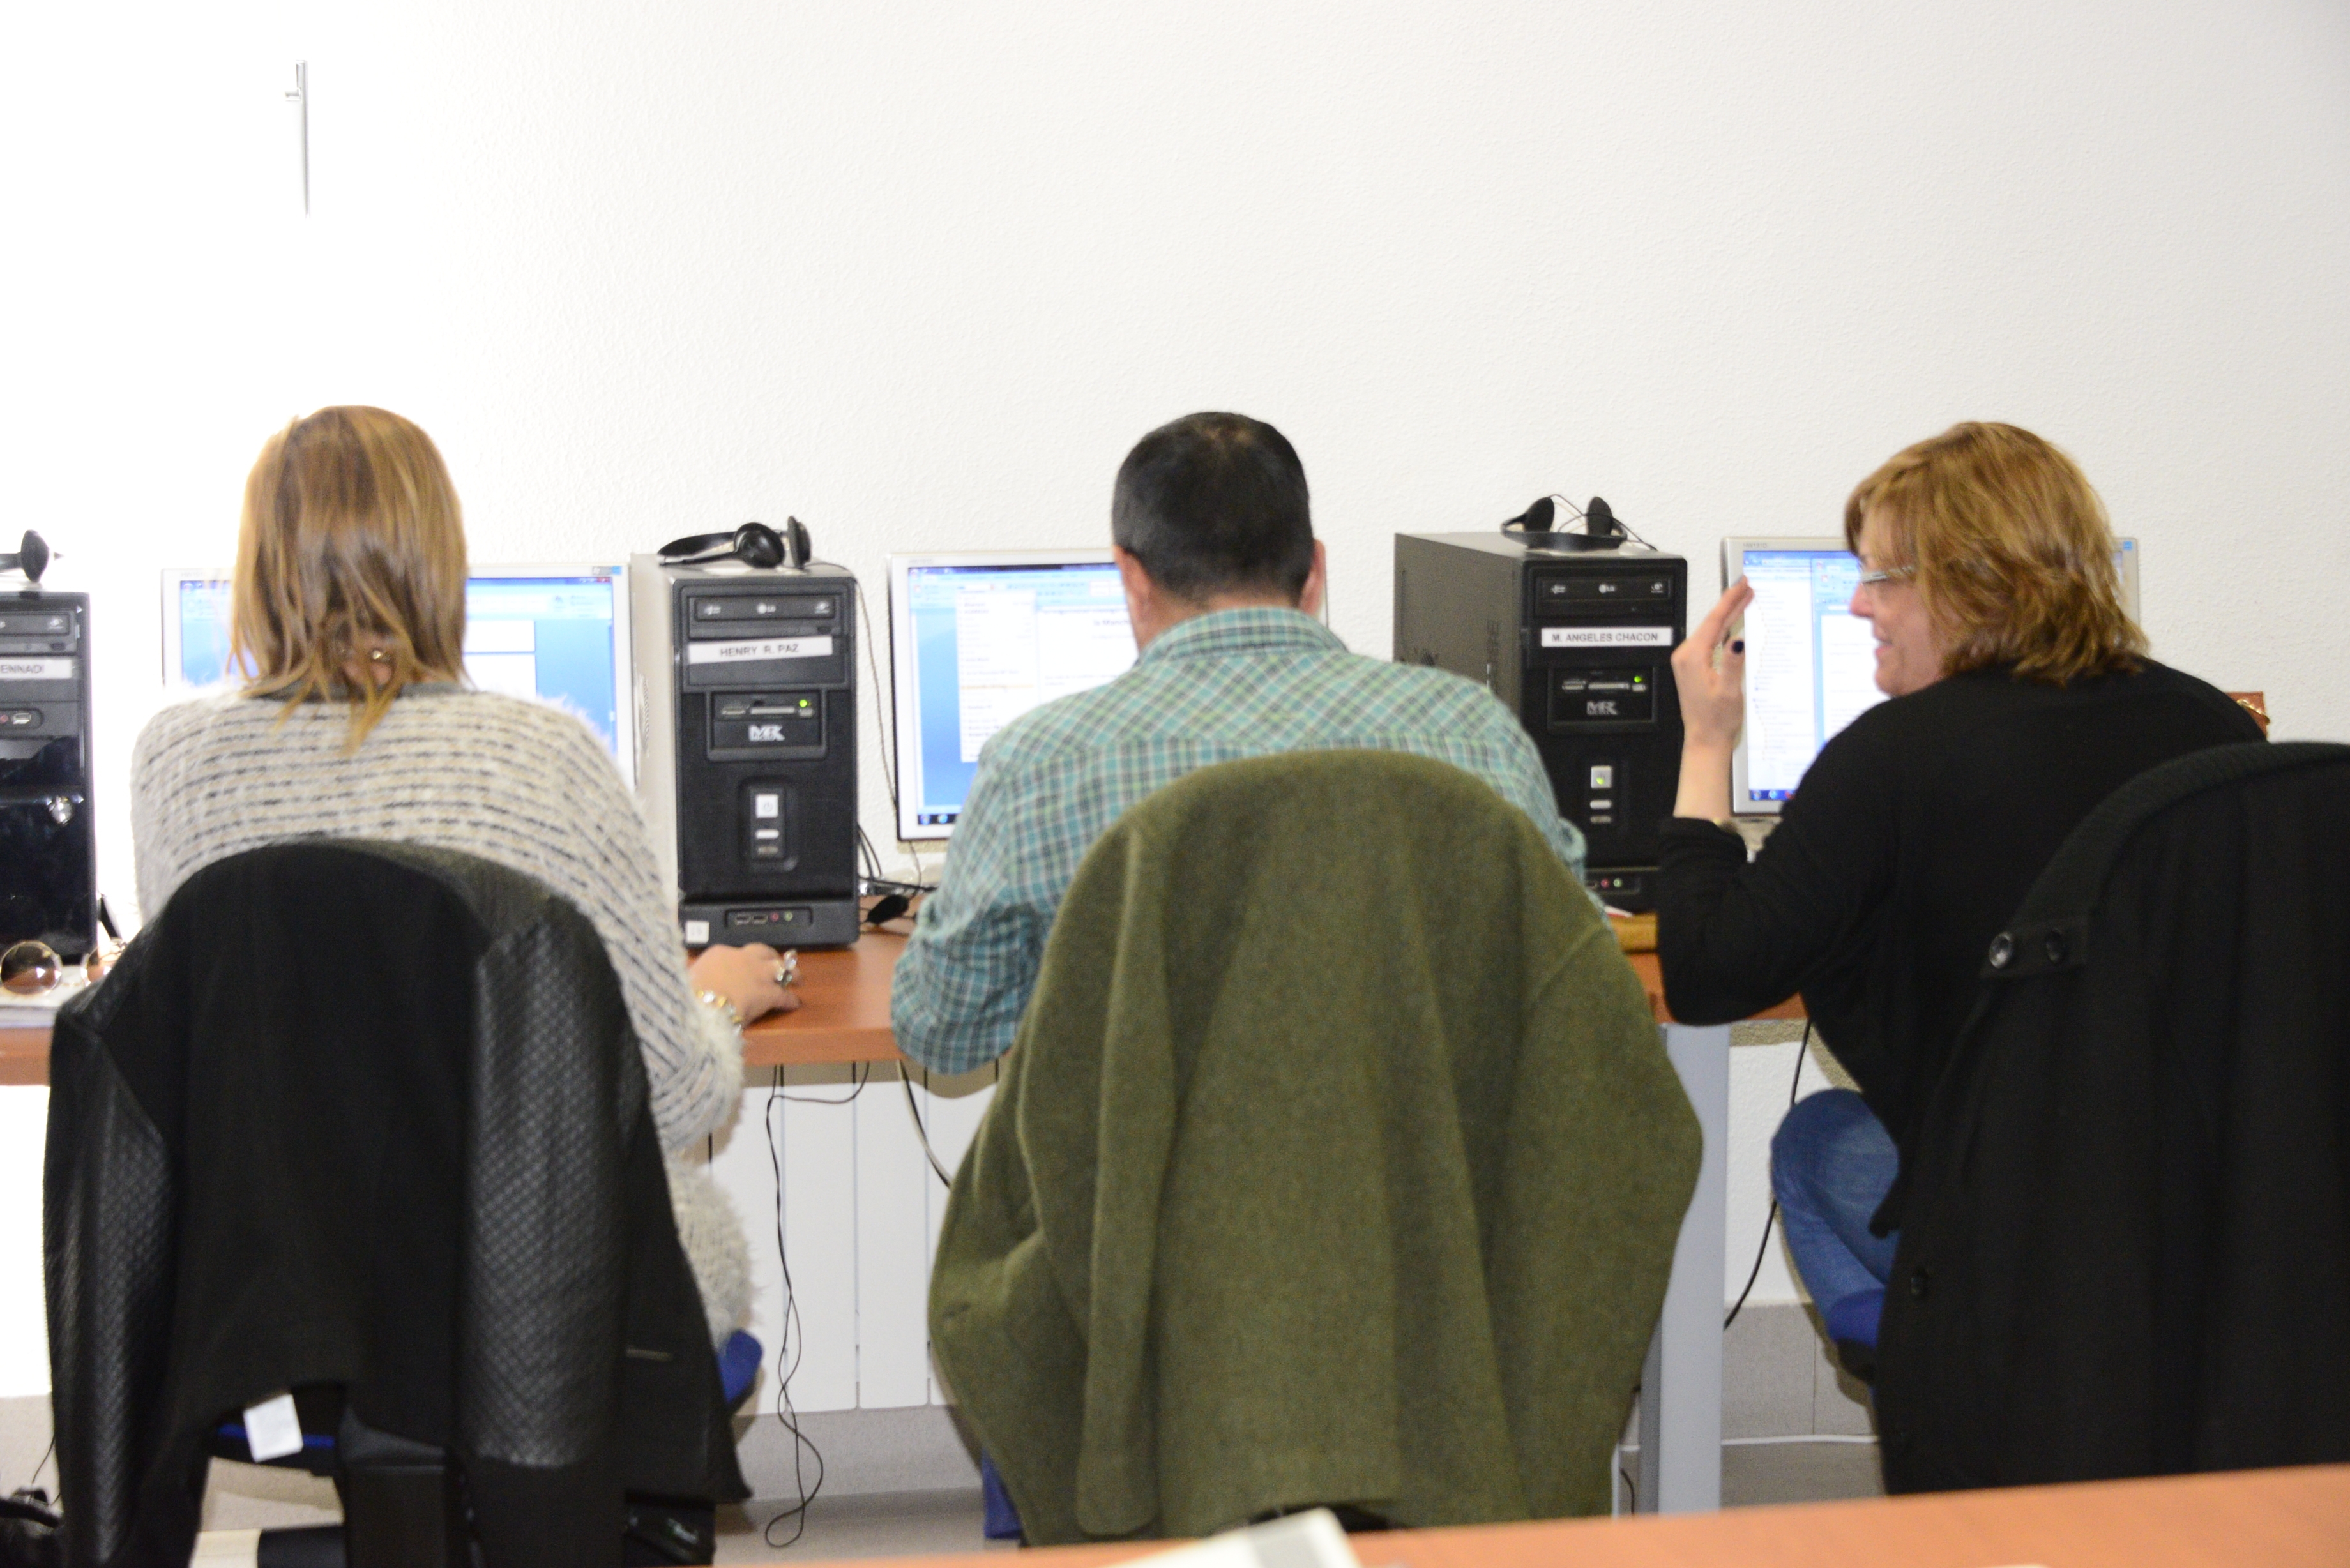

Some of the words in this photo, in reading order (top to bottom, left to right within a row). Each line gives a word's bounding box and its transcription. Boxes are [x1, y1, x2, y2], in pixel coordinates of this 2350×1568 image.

[1552, 634, 1561, 642] M.
[1566, 633, 1612, 642] ANGELES
[1615, 633, 1658, 642] CHACON
[720, 646, 757, 657] HENRY
[764, 645, 774, 654] R.
[778, 644, 798, 652] PAZ
